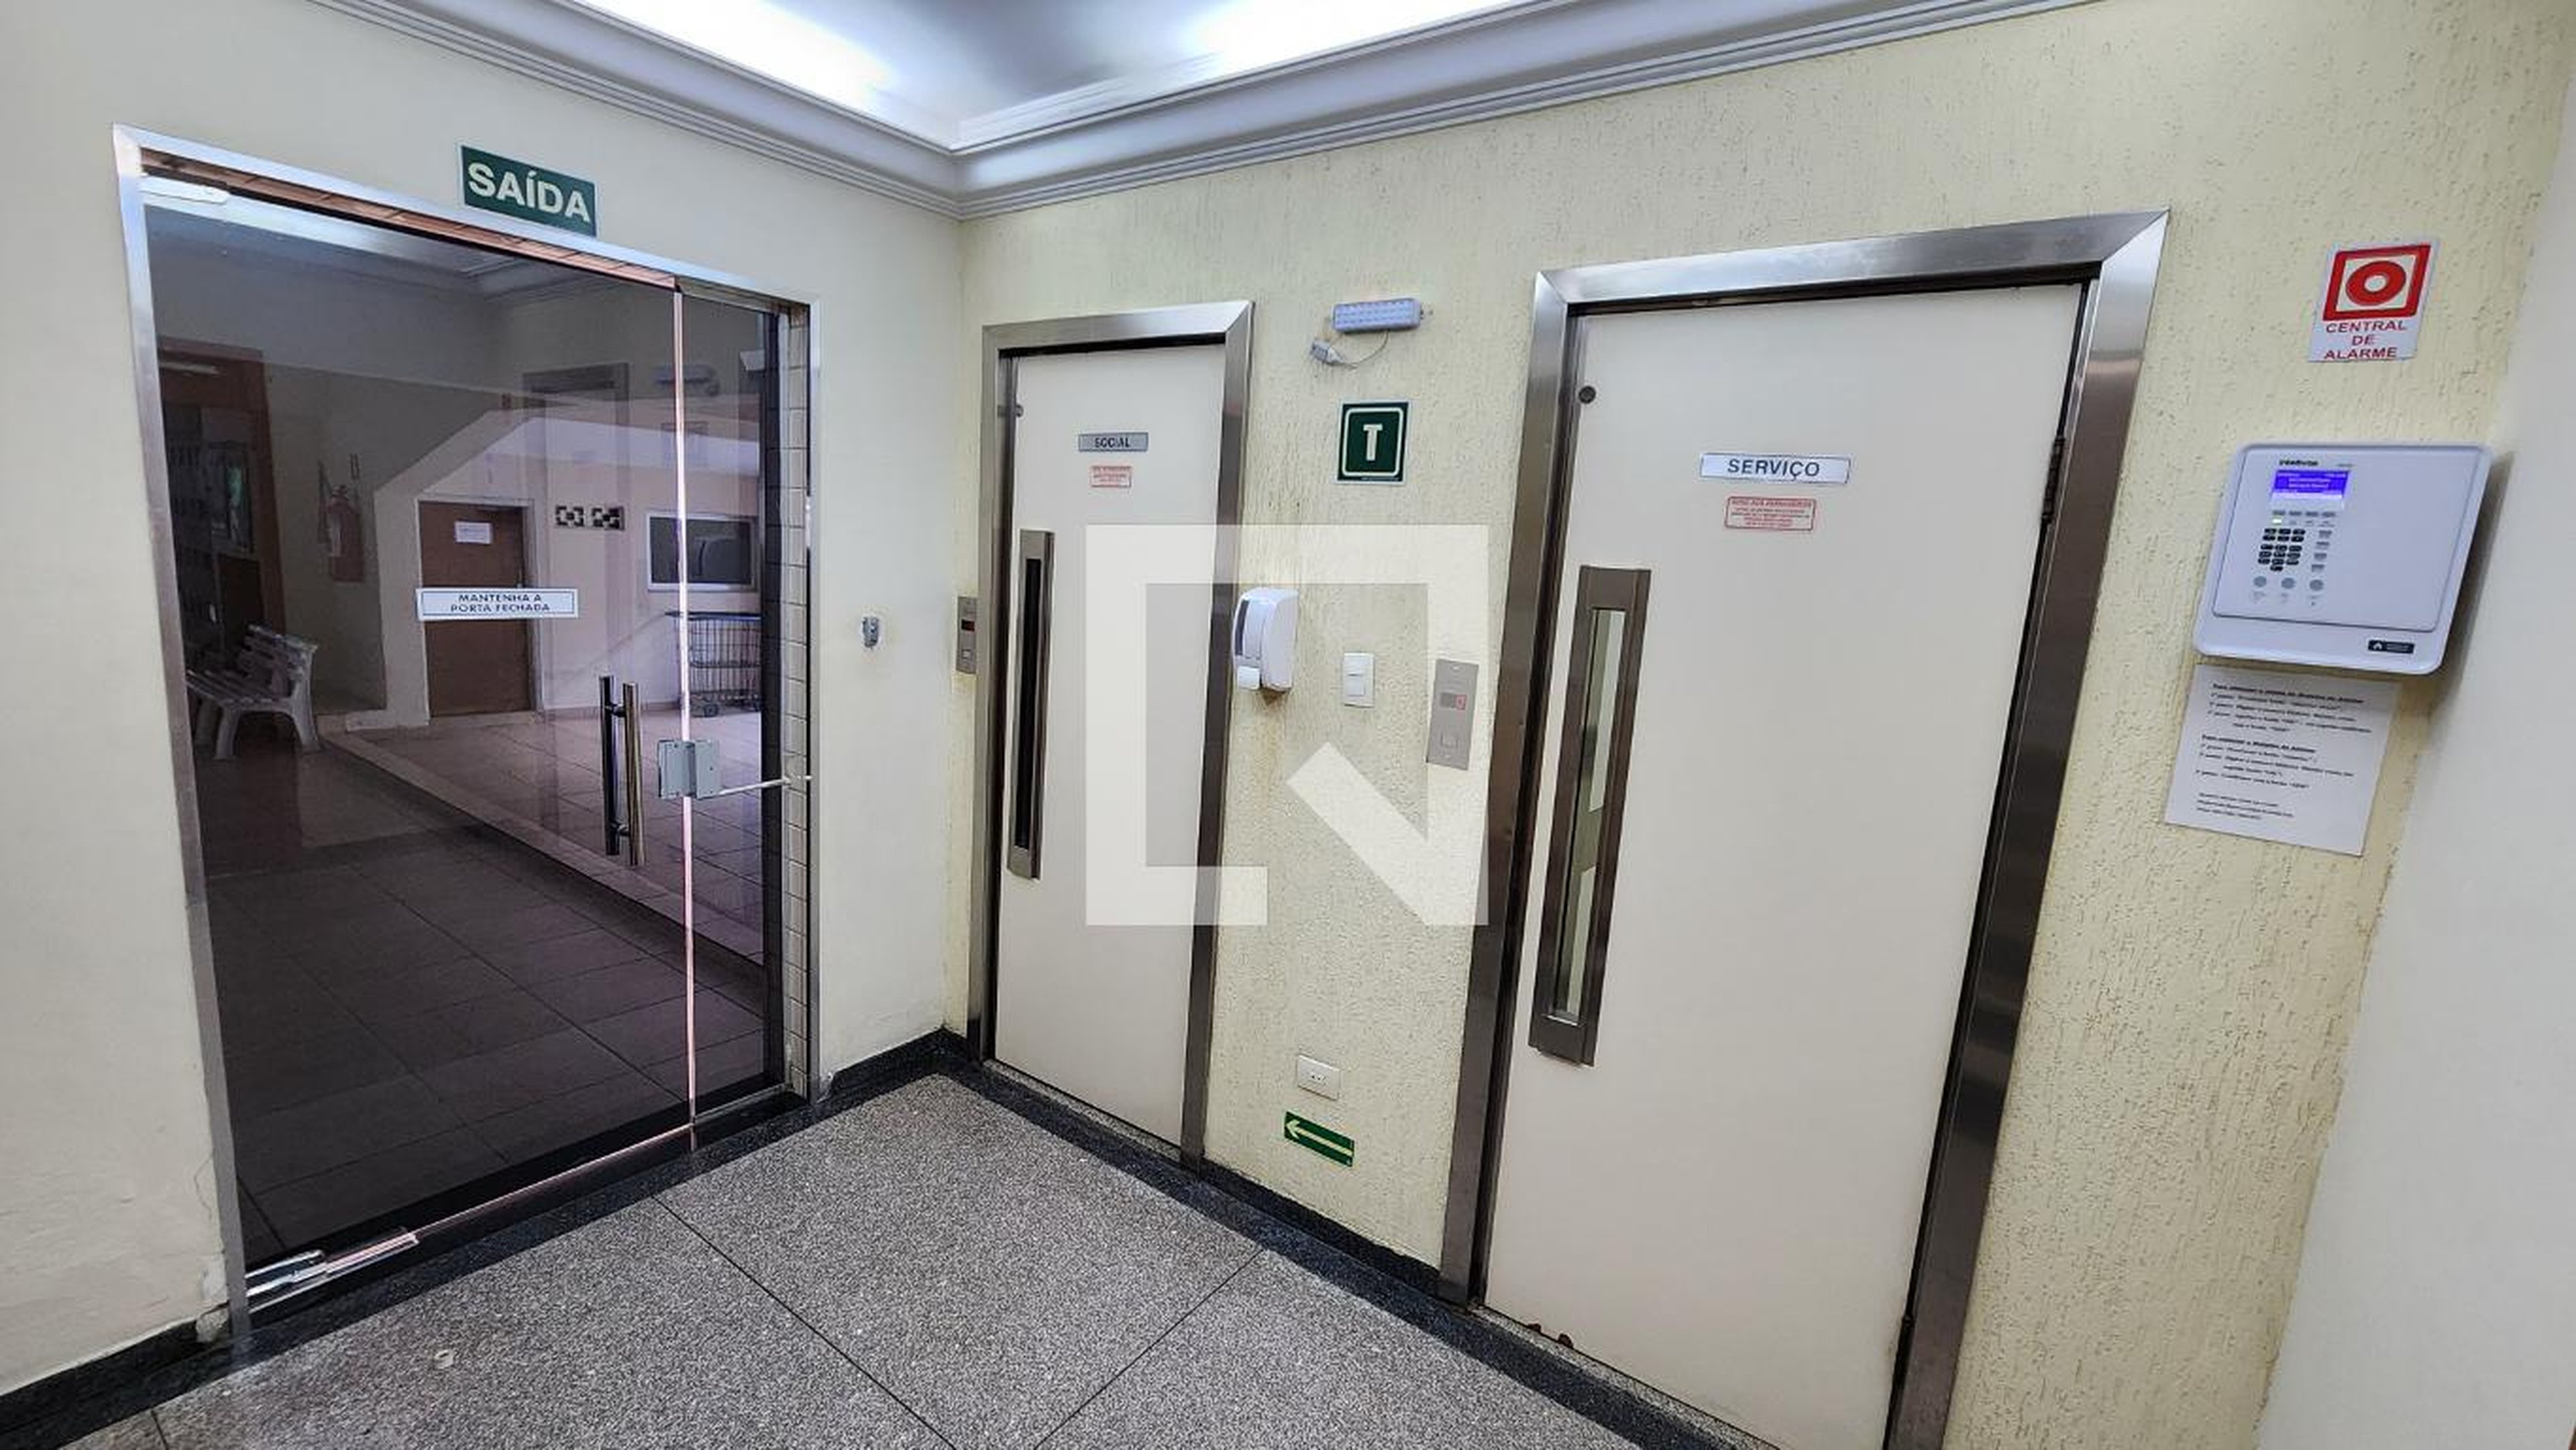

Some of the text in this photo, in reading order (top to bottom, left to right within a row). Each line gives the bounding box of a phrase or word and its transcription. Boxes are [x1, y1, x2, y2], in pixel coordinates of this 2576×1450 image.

[468, 162, 591, 223] SAÍDA
[2326, 321, 2407, 333] CENTRAL
[2351, 335, 2375, 345] DE
[2324, 347, 2398, 359] ALARME
[1362, 423, 1383, 461] T
[1727, 458, 1820, 480] SERVIÇO
[458, 594, 542, 602] MANTENHA A
[450, 604, 550, 612] PORTA FECHADA
